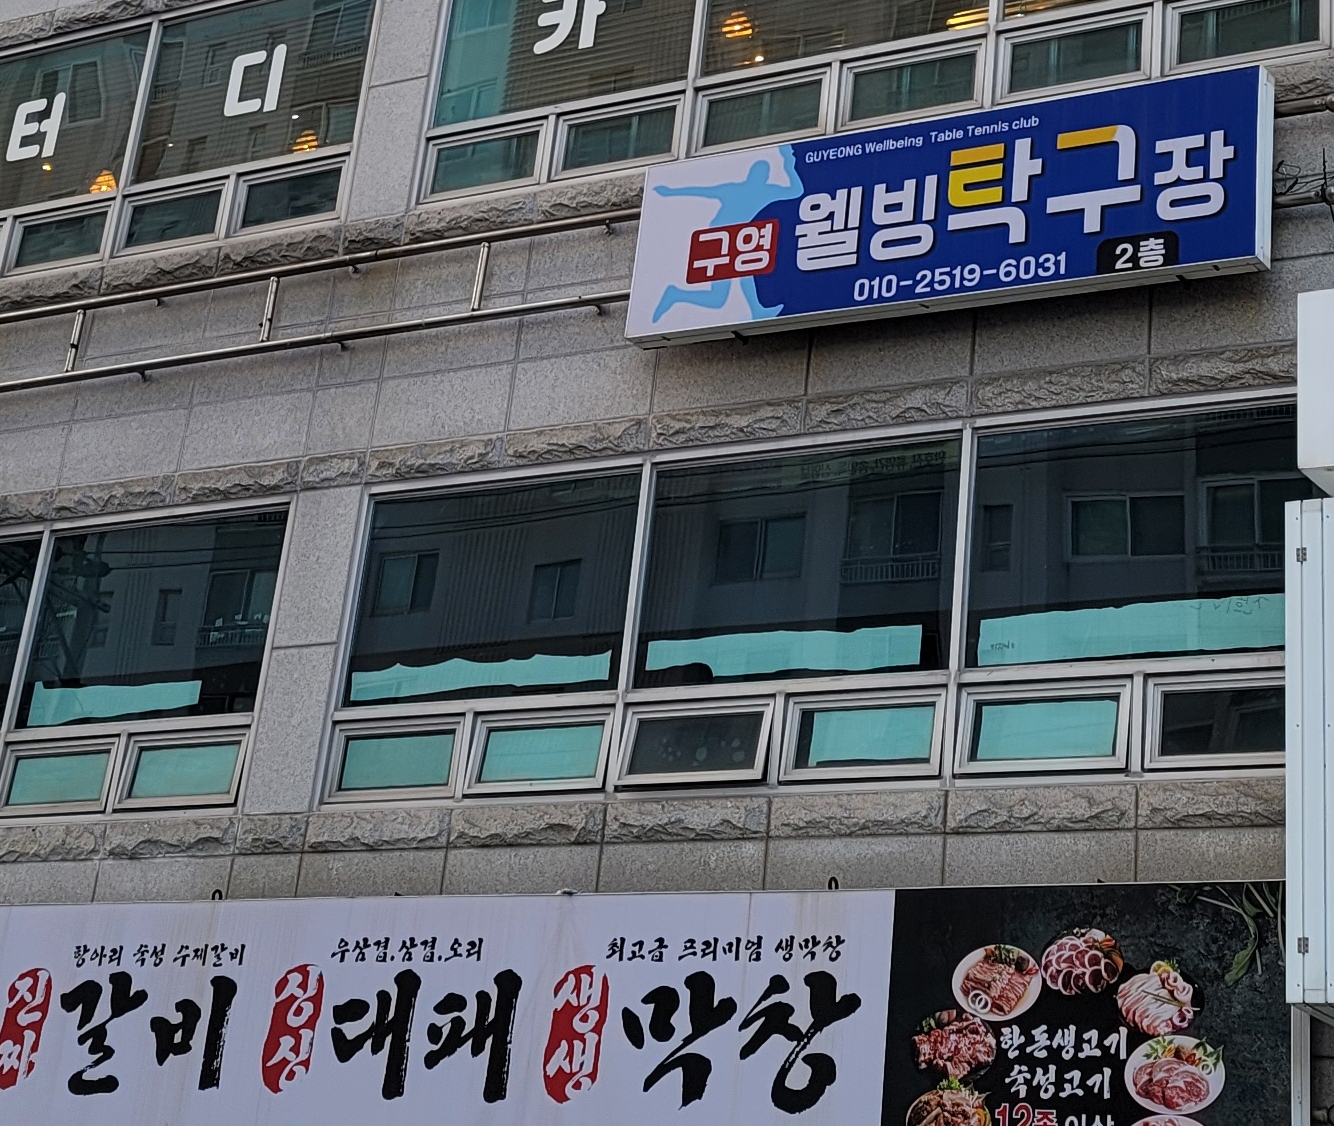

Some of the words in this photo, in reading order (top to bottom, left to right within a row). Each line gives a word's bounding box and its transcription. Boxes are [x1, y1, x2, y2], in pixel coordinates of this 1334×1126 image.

[804, 143, 863, 164] GUYEONG
[864, 135, 924, 154] Wellbeing
[929, 129, 964, 144] Table
[966, 120, 1010, 138] Tennis
[1011, 115, 1040, 129] club
[691, 224, 773, 277] 구영
[793, 124, 1236, 272] 웰빙탁구장
[853, 251, 1068, 302] 010-2519-6031
[1113, 235, 1167, 270] 2층
[72, 944, 124, 968] 항아리
[132, 943, 166, 968] 숙성
[172, 942, 247, 968] 수제갈비
[605, 936, 669, 963] 최고급
[677, 935, 764, 963] 프리미엄
[774, 934, 846, 963] 생막창
[59, 971, 238, 1095] 갈비
[329, 969, 524, 1104] 대패
[547, 965, 608, 1094] 생생
[620, 970, 862, 1114] 막창
[999, 1024, 1129, 1061] 한돈생고기
[1004, 1063, 1113, 1100] 숙성고기
